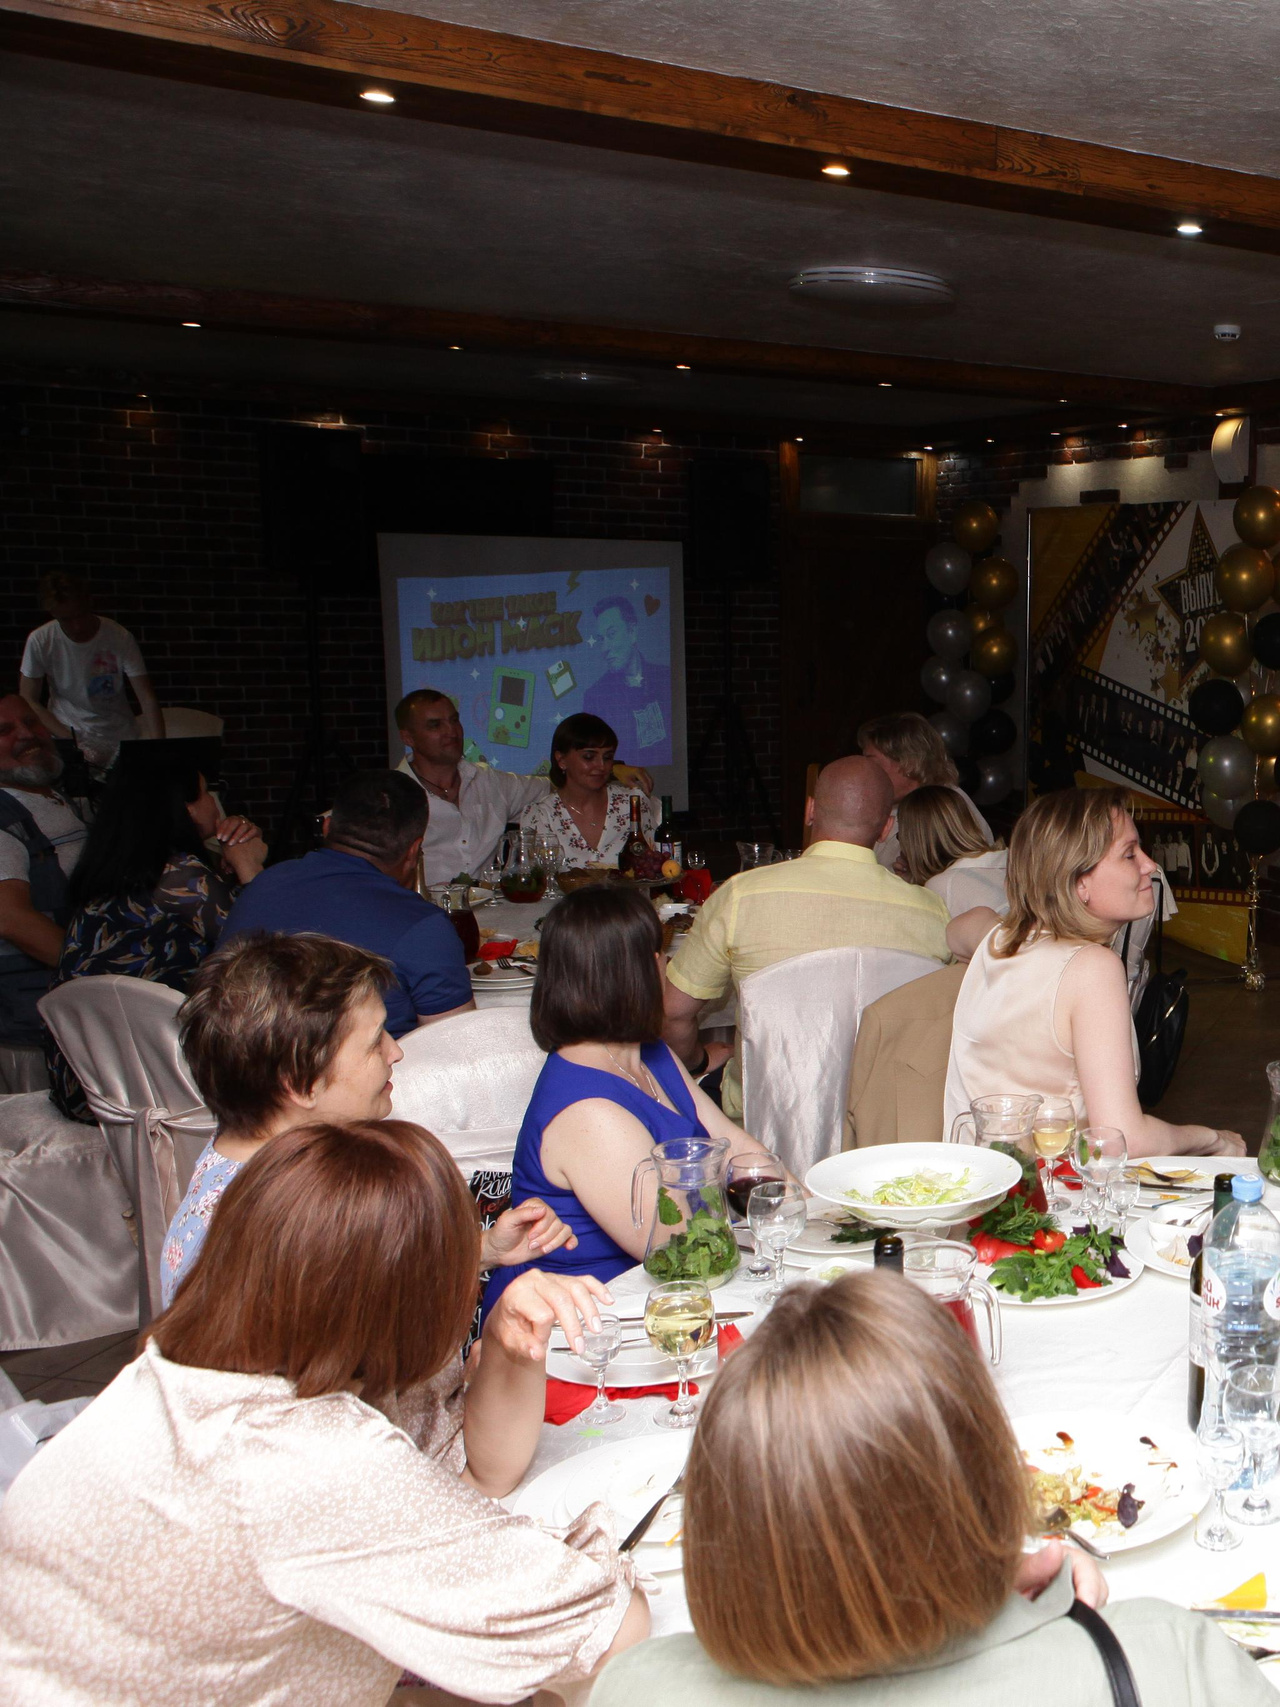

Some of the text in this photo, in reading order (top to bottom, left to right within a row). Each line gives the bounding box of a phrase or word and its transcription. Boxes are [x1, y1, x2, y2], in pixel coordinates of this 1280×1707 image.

[430, 600, 467, 626] КАК
[1184, 610, 1227, 652] 20
[412, 610, 583, 661] ИЛОН МАСК
